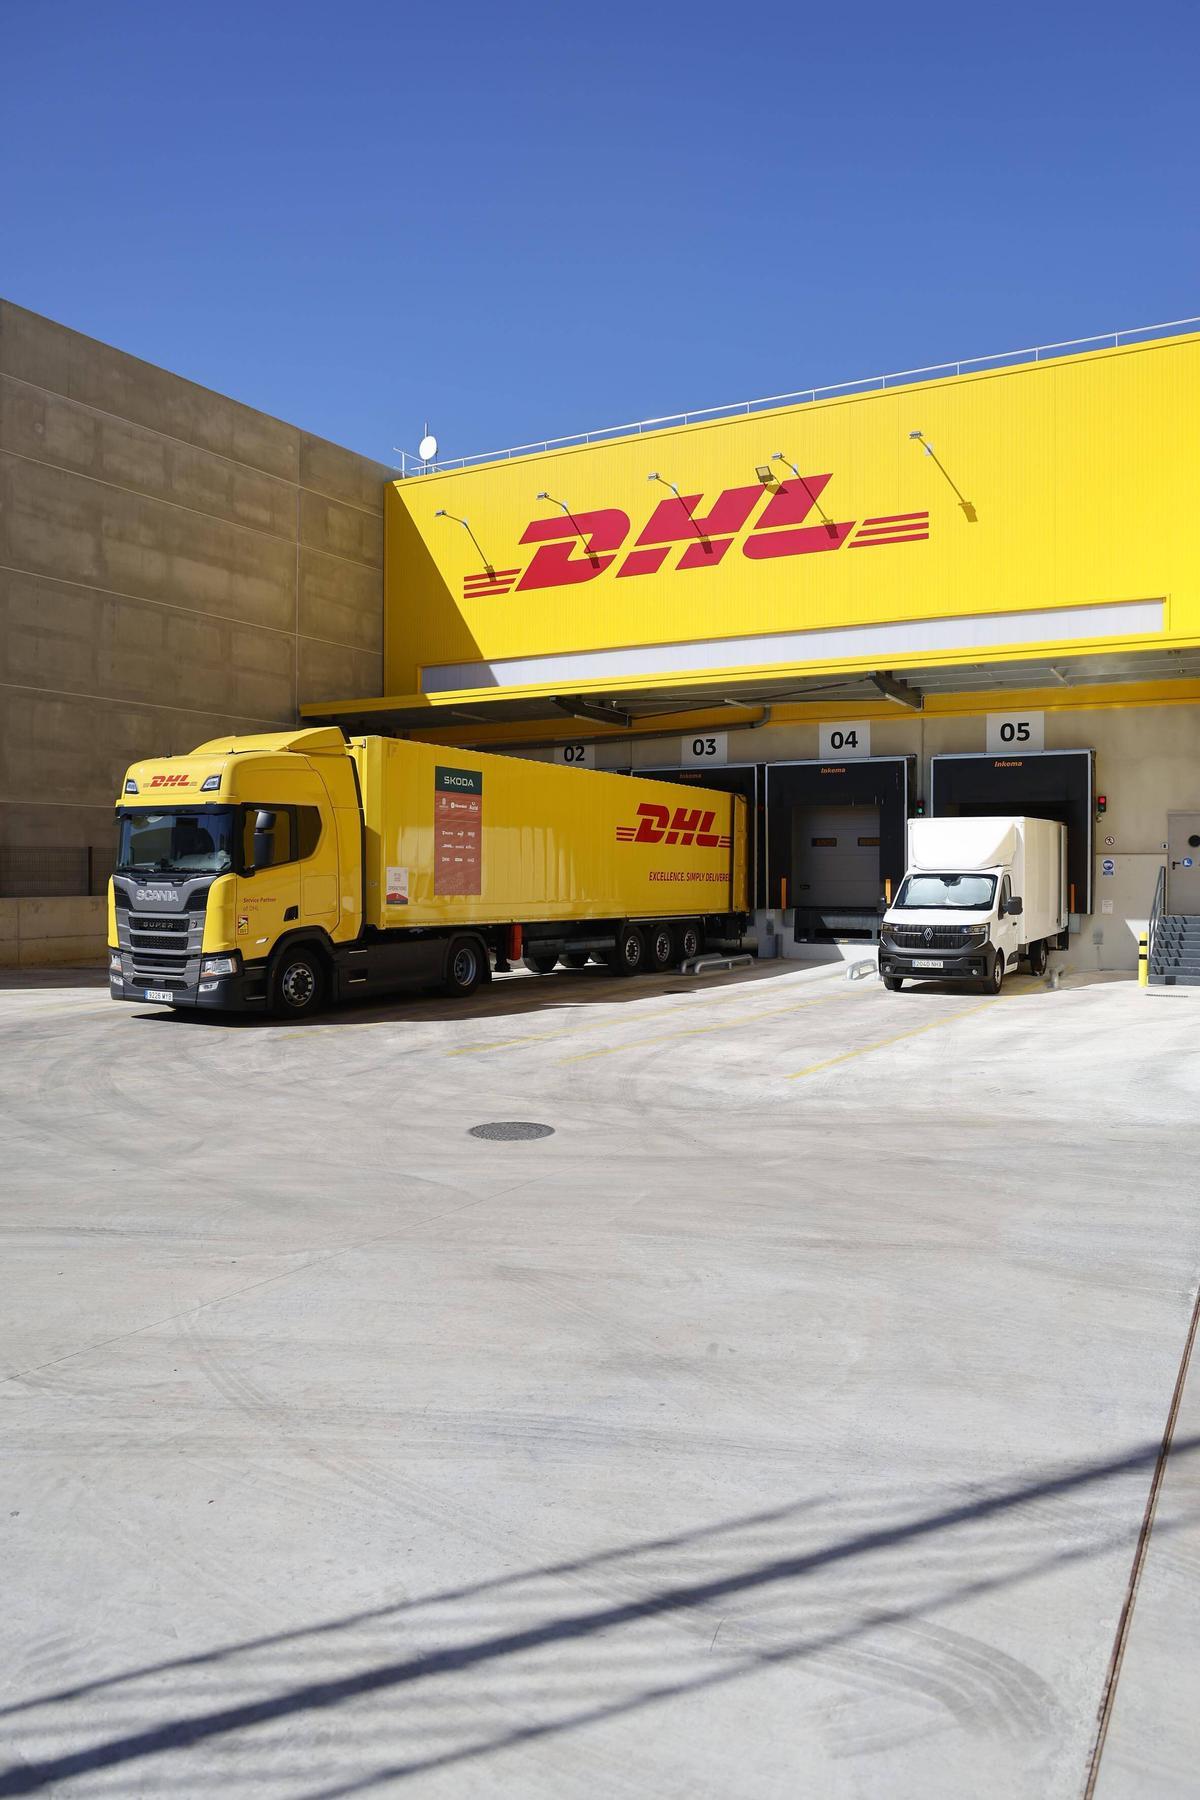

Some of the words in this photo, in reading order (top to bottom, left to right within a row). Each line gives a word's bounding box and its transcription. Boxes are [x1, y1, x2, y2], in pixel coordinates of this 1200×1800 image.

[514, 473, 857, 592] DHL
[830, 731, 858, 749] 04
[1000, 722, 1030, 742] 05
[563, 745, 585, 762] 02
[692, 738, 717, 756] 03
[150, 774, 190, 788] DHL
[634, 802, 720, 848] DHL
[686, 872, 705, 882] SIMPLY
[705, 872, 731, 882] DELIVERE
[136, 889, 179, 902] SCANIA
[143, 921, 174, 929] SUPER
